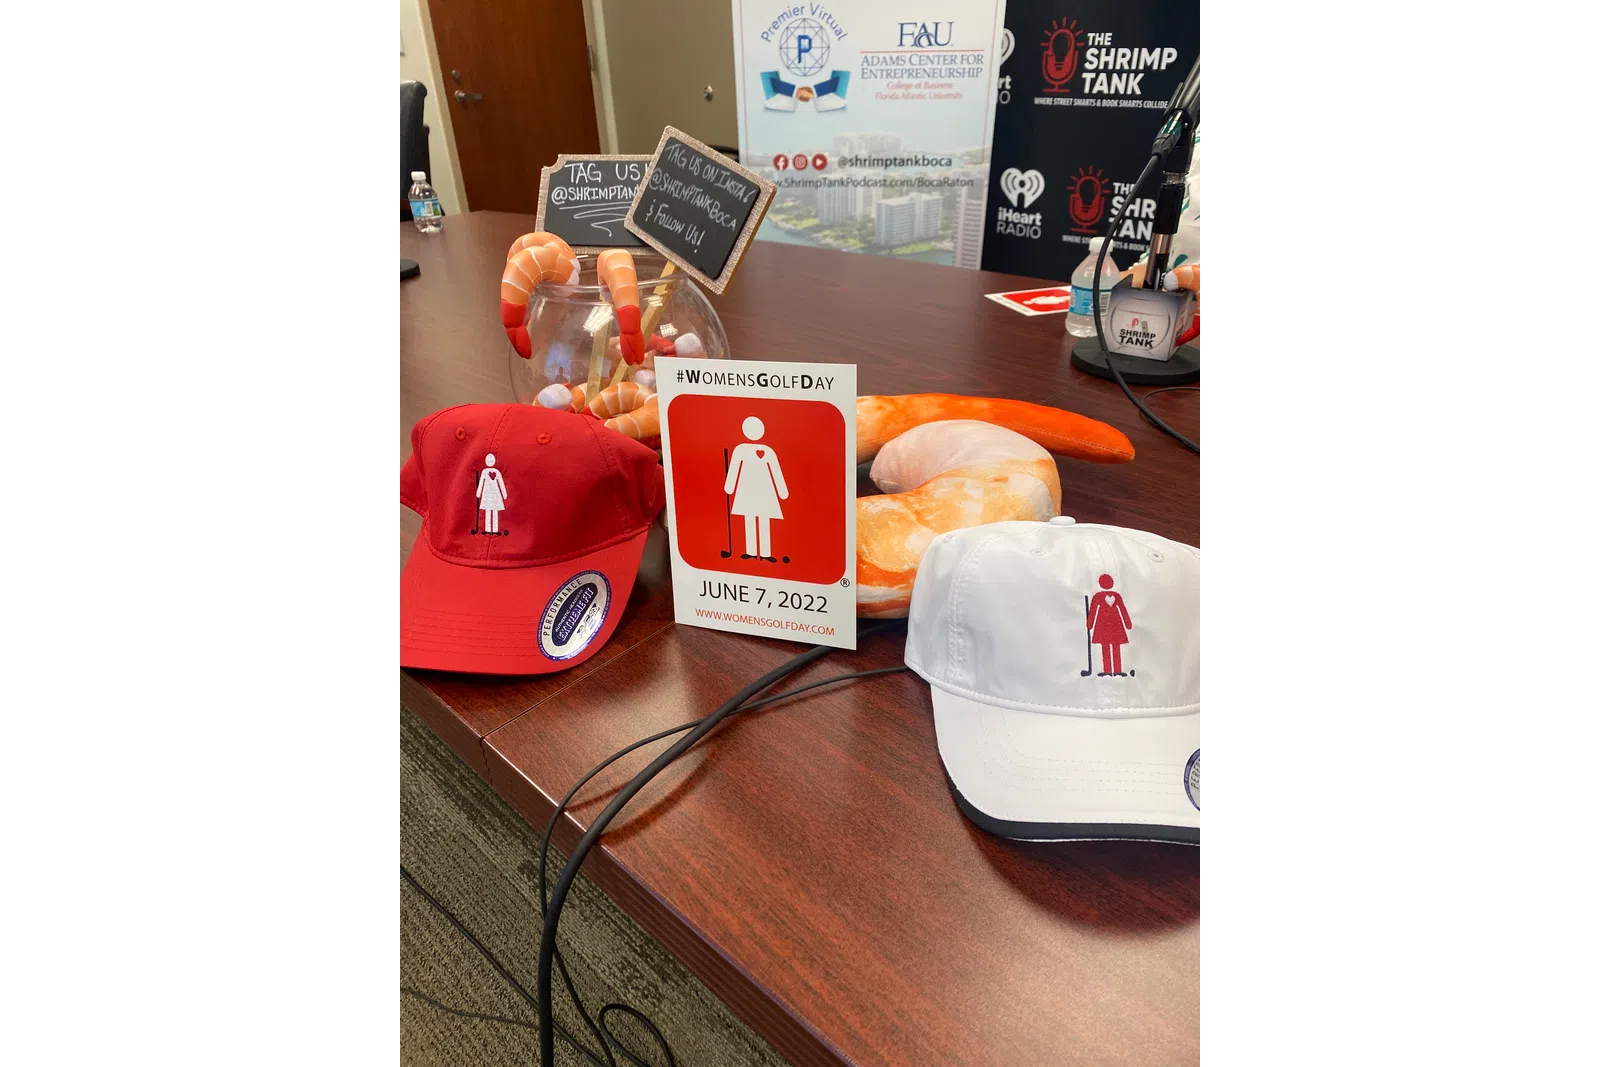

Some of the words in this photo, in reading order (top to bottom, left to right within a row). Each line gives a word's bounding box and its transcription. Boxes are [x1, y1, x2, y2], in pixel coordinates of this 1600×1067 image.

[760, 6, 805, 42] Premier
[810, 2, 848, 41] Virtual
[897, 21, 955, 48] FAU
[1087, 32, 1113, 46] THE
[860, 54, 906, 66] ADAMS
[908, 53, 957, 66] CENTER
[960, 53, 984, 65] FOR
[1084, 47, 1178, 70] SHRIMP
[860, 67, 984, 79] ENTREPRENEURSHIP
[1081, 72, 1145, 95] TANK
[1034, 97, 1053, 105] WHERE
[1053, 97, 1073, 106] STREET
[1073, 98, 1096, 106] SMARTS
[1101, 99, 1118, 107] BOOK
[1119, 99, 1142, 108] SMARTS
[1143, 100, 1169, 109] COLLIDE
[664, 144, 687, 169] TAG
[688, 155, 703, 175] US
[702, 164, 719, 182] ON
[837, 154, 953, 169] @shrimptankboca
[564, 163, 601, 184] TAG
[551, 184, 641, 205] @SHRIMPTAN
[649, 167, 737, 232] @SHRIMPTANKBOCA
[998, 206, 1042, 226] iHeart
[996, 221, 1042, 240] RADIO
[1119, 336, 1154, 349] TANK
[1120, 329, 1156, 340] SHRIMP
[543, 578, 582, 636] PERFORMANCE
[700, 580, 750, 603] JUNE
[755, 588, 772, 608] 7,
[778, 591, 828, 613] 2022
[695, 608, 835, 636] WWW.WOMENSGOLFDAY.COM
